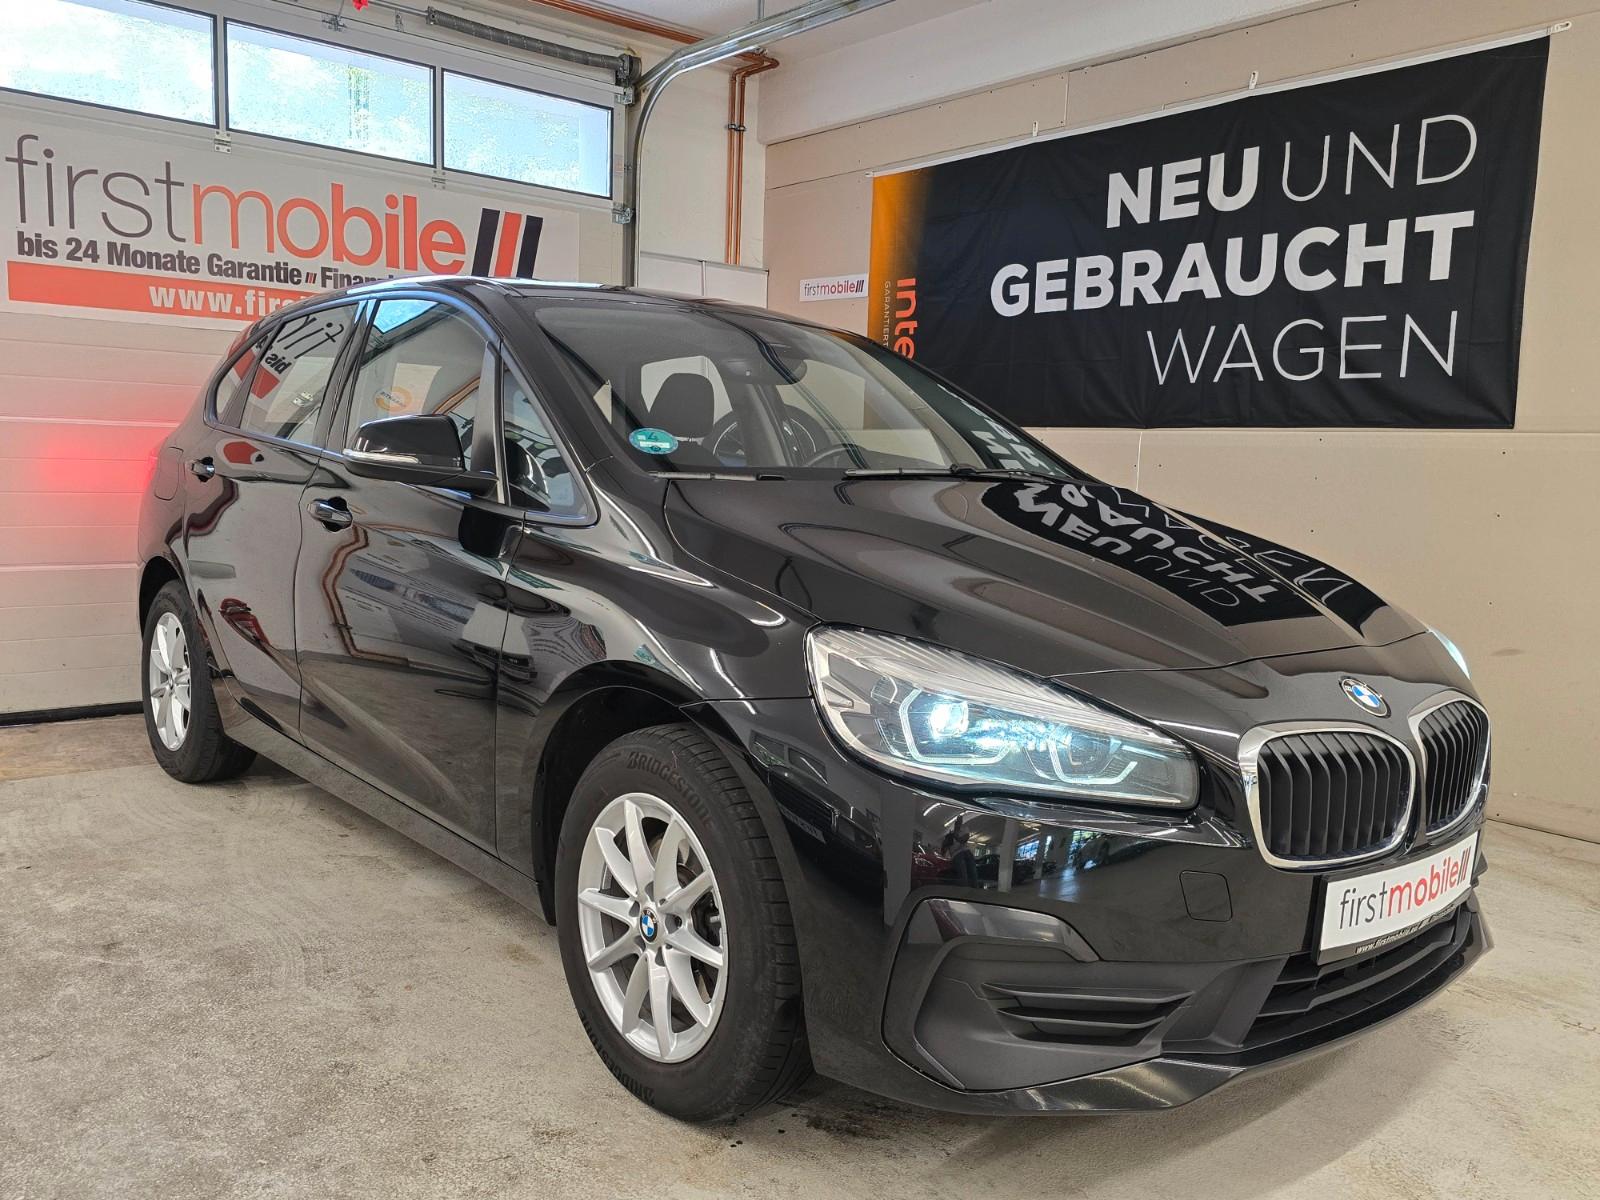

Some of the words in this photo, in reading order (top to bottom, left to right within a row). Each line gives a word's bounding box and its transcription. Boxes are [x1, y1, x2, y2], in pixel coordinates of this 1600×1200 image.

[5, 134, 467, 276] firstmobile
[1106, 146, 1260, 229] NEU
[1281, 114, 1477, 202] UND
[17, 231, 59, 259] bis
[65, 237, 100, 264] 24
[106, 241, 201, 274] Monate
[207, 253, 302, 286] Garantie
[804, 279, 856, 297] firstmobile
[990, 210, 1475, 317] GEBRAUCHT
[1146, 310, 1459, 386] WAGEN
[626, 751, 713, 829] BRIDGESTONE
[1340, 855, 1460, 930] firstmobile
